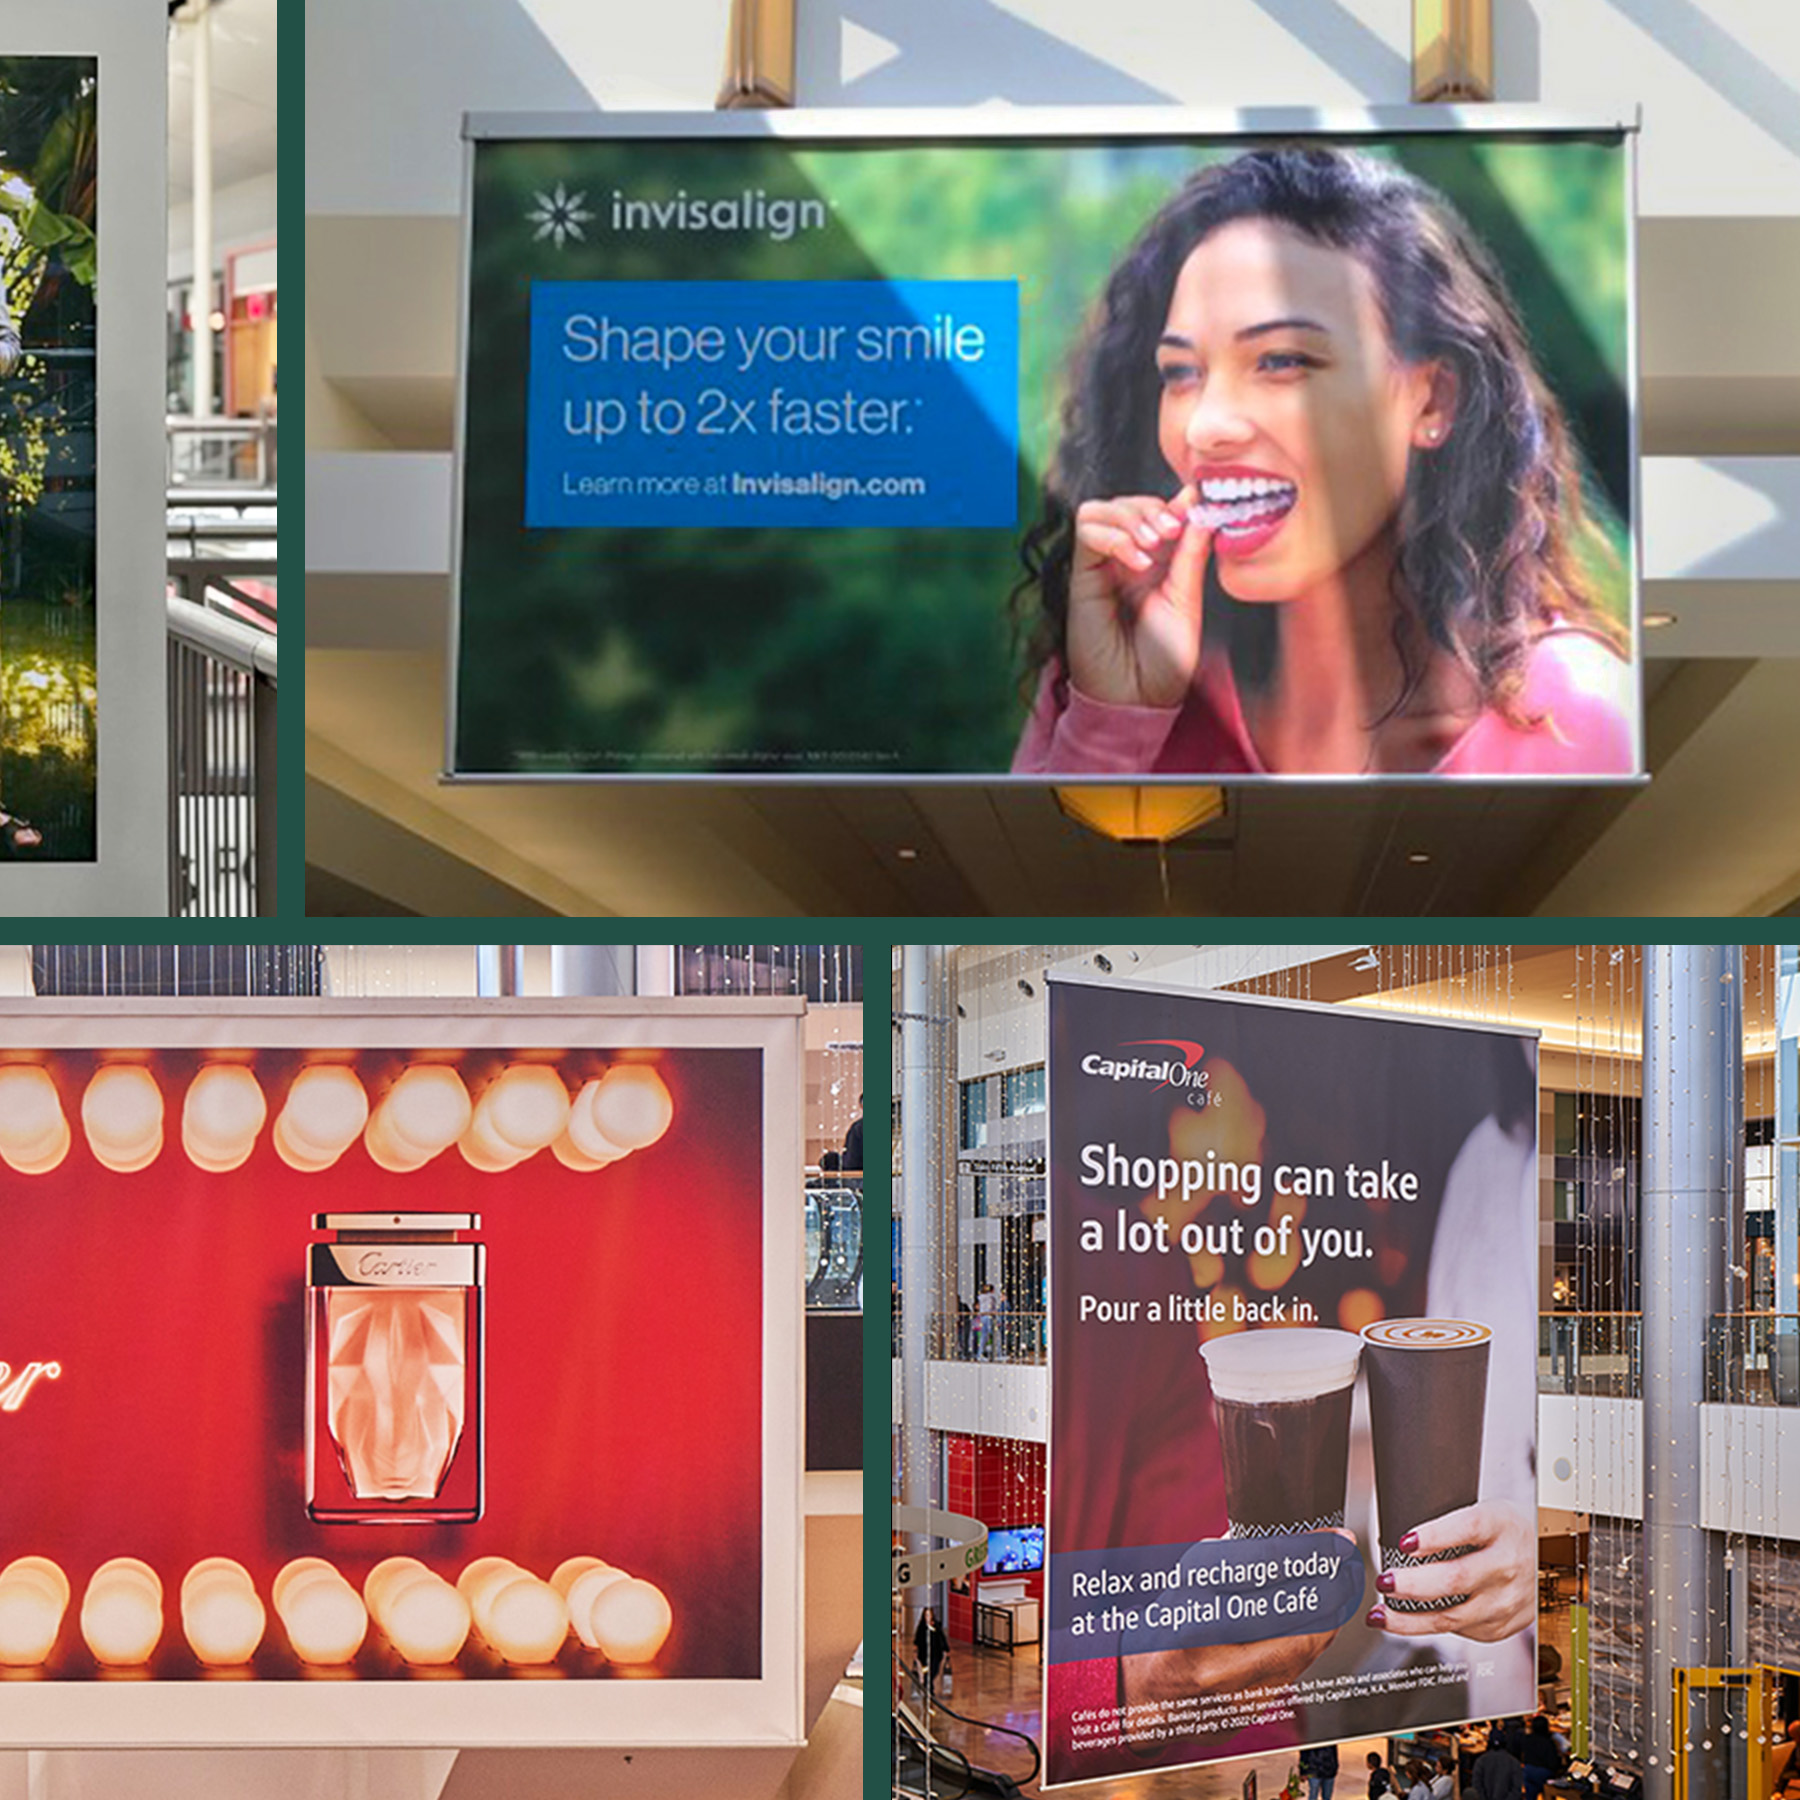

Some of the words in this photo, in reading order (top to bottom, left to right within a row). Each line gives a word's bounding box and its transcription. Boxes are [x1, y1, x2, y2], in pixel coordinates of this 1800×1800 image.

[612, 190, 826, 241] invisalign
[562, 314, 727, 371] Shape
[735, 324, 847, 372] your
[856, 314, 986, 362] smile
[564, 398, 628, 444] up
[637, 390, 687, 435] to
[696, 388, 758, 435] 2x
[563, 472, 635, 496] Learn
[637, 477, 699, 496] more
[704, 474, 727, 496] at
[731, 471, 926, 499] Invisalign.com
[1186, 1089, 1223, 1107] café
[1079, 1142, 1262, 1205] Shopping
[1273, 1163, 1335, 1197] can
[1345, 1160, 1419, 1201] take
[1080, 1220, 1103, 1252] a
[1117, 1208, 1170, 1253] lot
[1180, 1218, 1245, 1255] out
[1254, 1214, 1293, 1256] of
[1302, 1226, 1374, 1268] you.
[1079, 1295, 1140, 1322] Pour
[1147, 1301, 1162, 1322] a
[1168, 1294, 1226, 1322] little
[1233, 1295, 1286, 1323] back
[1292, 1296, 1319, 1323] in.
[1072, 1569, 1135, 1598] Relax
[1139, 1563, 1182, 1592] and
[1187, 1558, 1278, 1588] recharge
[1283, 1551, 1342, 1580] today
[1071, 1611, 1095, 1636] at
[1101, 1605, 1139, 1633] the
[1145, 1596, 1221, 1632] Capital
[1226, 1594, 1268, 1621] One
[1273, 1586, 1319, 1614] Café
[1098, 1707, 1110, 1719] do
[1111, 1706, 1126, 1718] not
[1128, 1700, 1159, 1716] provide
[1160, 1699, 1175, 1711] the
[1176, 1697, 1198, 1709] same
[1200, 1692, 1232, 1705] services
[1244, 1687, 1263, 1700] bank
[1302, 1680, 1315, 1691] but
[1316, 1678, 1335, 1689] have
[1357, 1671, 1370, 1683] and
[1168, 1709, 1200, 1723] Banking
[1202, 1705, 1238, 1720] products
[1239, 1701, 1255, 1713] and
[1325, 1687, 1351, 1702] Capital
[1118, 1728, 1155, 1746] provided
[1156, 1728, 1167, 1741] by
[1175, 1723, 1195, 1736] third
[1251, 1710, 1277, 1725] Capital
